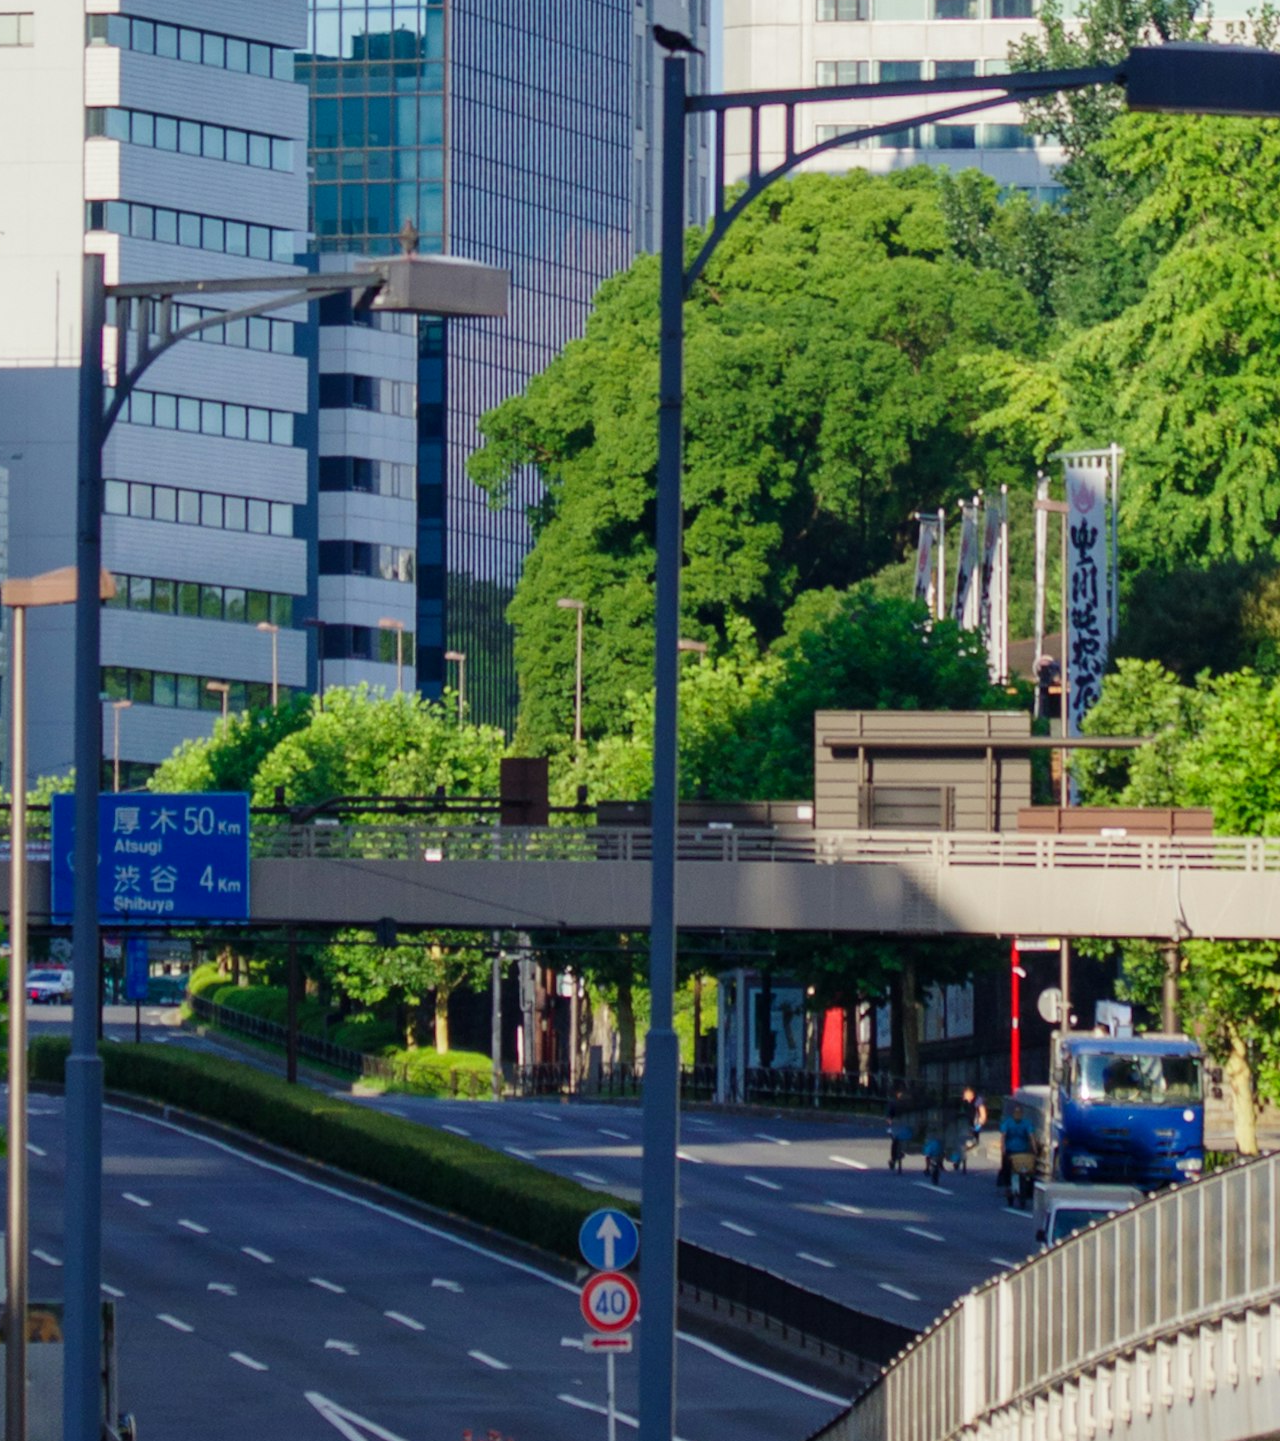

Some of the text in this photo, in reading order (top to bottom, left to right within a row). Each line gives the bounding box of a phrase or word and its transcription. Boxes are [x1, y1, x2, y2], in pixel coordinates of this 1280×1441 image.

[113, 807, 178, 835] 厚木
[114, 839, 163, 855] Atsugi
[114, 866, 178, 893] 渋谷
[113, 896, 175, 913] Shibuya
[595, 1289, 627, 1316] 40
